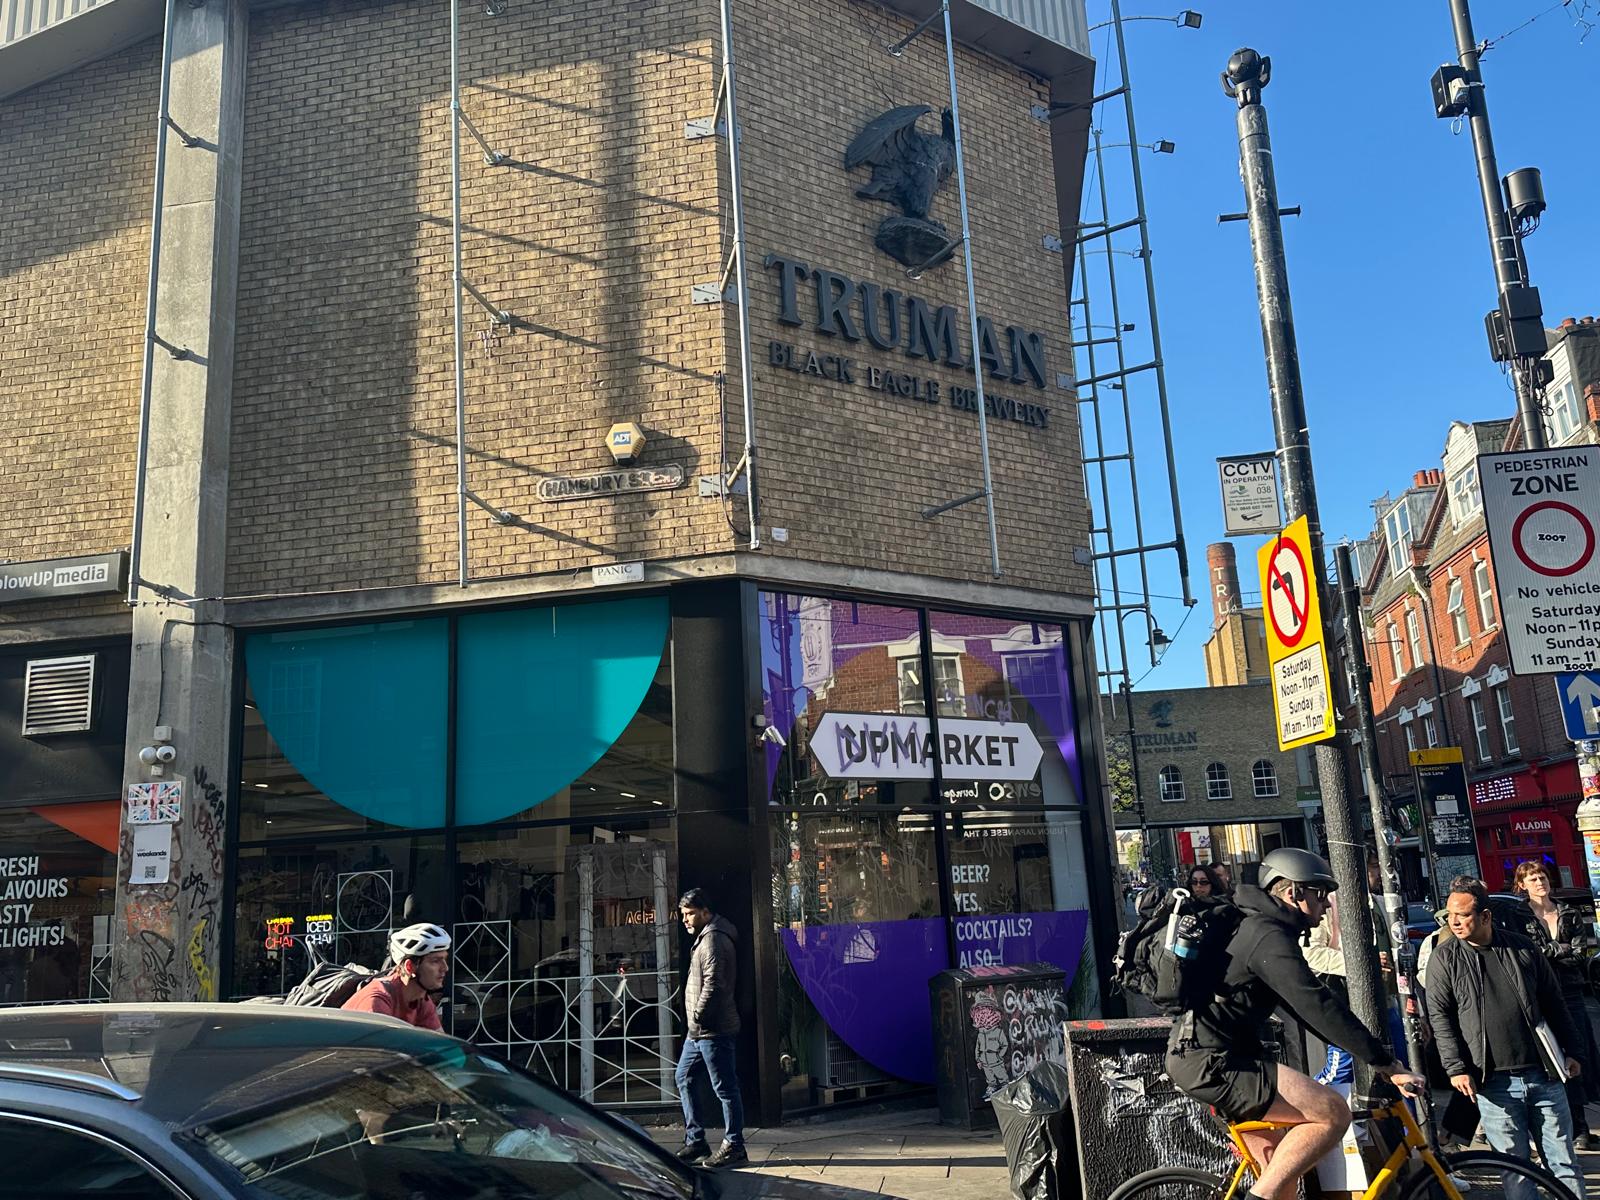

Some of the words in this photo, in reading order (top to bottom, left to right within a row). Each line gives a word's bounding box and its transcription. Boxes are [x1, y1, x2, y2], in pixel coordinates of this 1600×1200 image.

[764, 253, 1048, 389] TRUMAN
[768, 341, 855, 384] BLACK
[868, 366, 940, 404] EAGLE
[950, 385, 1050, 429] BREWERY
[613, 433, 631, 443] ADT
[1223, 461, 1271, 477] CCTV
[1494, 455, 1588, 474] PEDESTRIAN
[1233, 475, 1274, 484] OPERATION
[1510, 473, 1579, 496] ZONE
[1256, 486, 1272, 494] 038
[1537, 533, 1567, 542] ZOOT
[598, 565, 632, 576] PANIC
[1517, 587, 1539, 599] No
[1531, 604, 1600, 619] Saturday
[1525, 623, 1566, 635] Noon
[1546, 636, 1600, 649] Sunday
[1281, 657, 1312, 679] Saturday
[1564, 663, 1594, 671] ZOOT
[1280, 682, 1298, 698] Noon
[1288, 697, 1314, 715] Sunday
[844, 723, 1018, 766] UPMARKET
[1515, 820, 1552, 831] ALADIN
[951, 864, 990, 884] BEER?
[0, 878, 68, 900] AVOURS
[953, 892, 982, 912] YES.
[0, 903, 34, 924] STY
[267, 922, 292, 936] HOT
[306, 920, 331, 934] ICED
[956, 917, 1032, 941] COCKTAILS?
[265, 936, 293, 950] CHAI
[305, 933, 331, 945] CHAI
[959, 948, 996, 969] ALSO.
